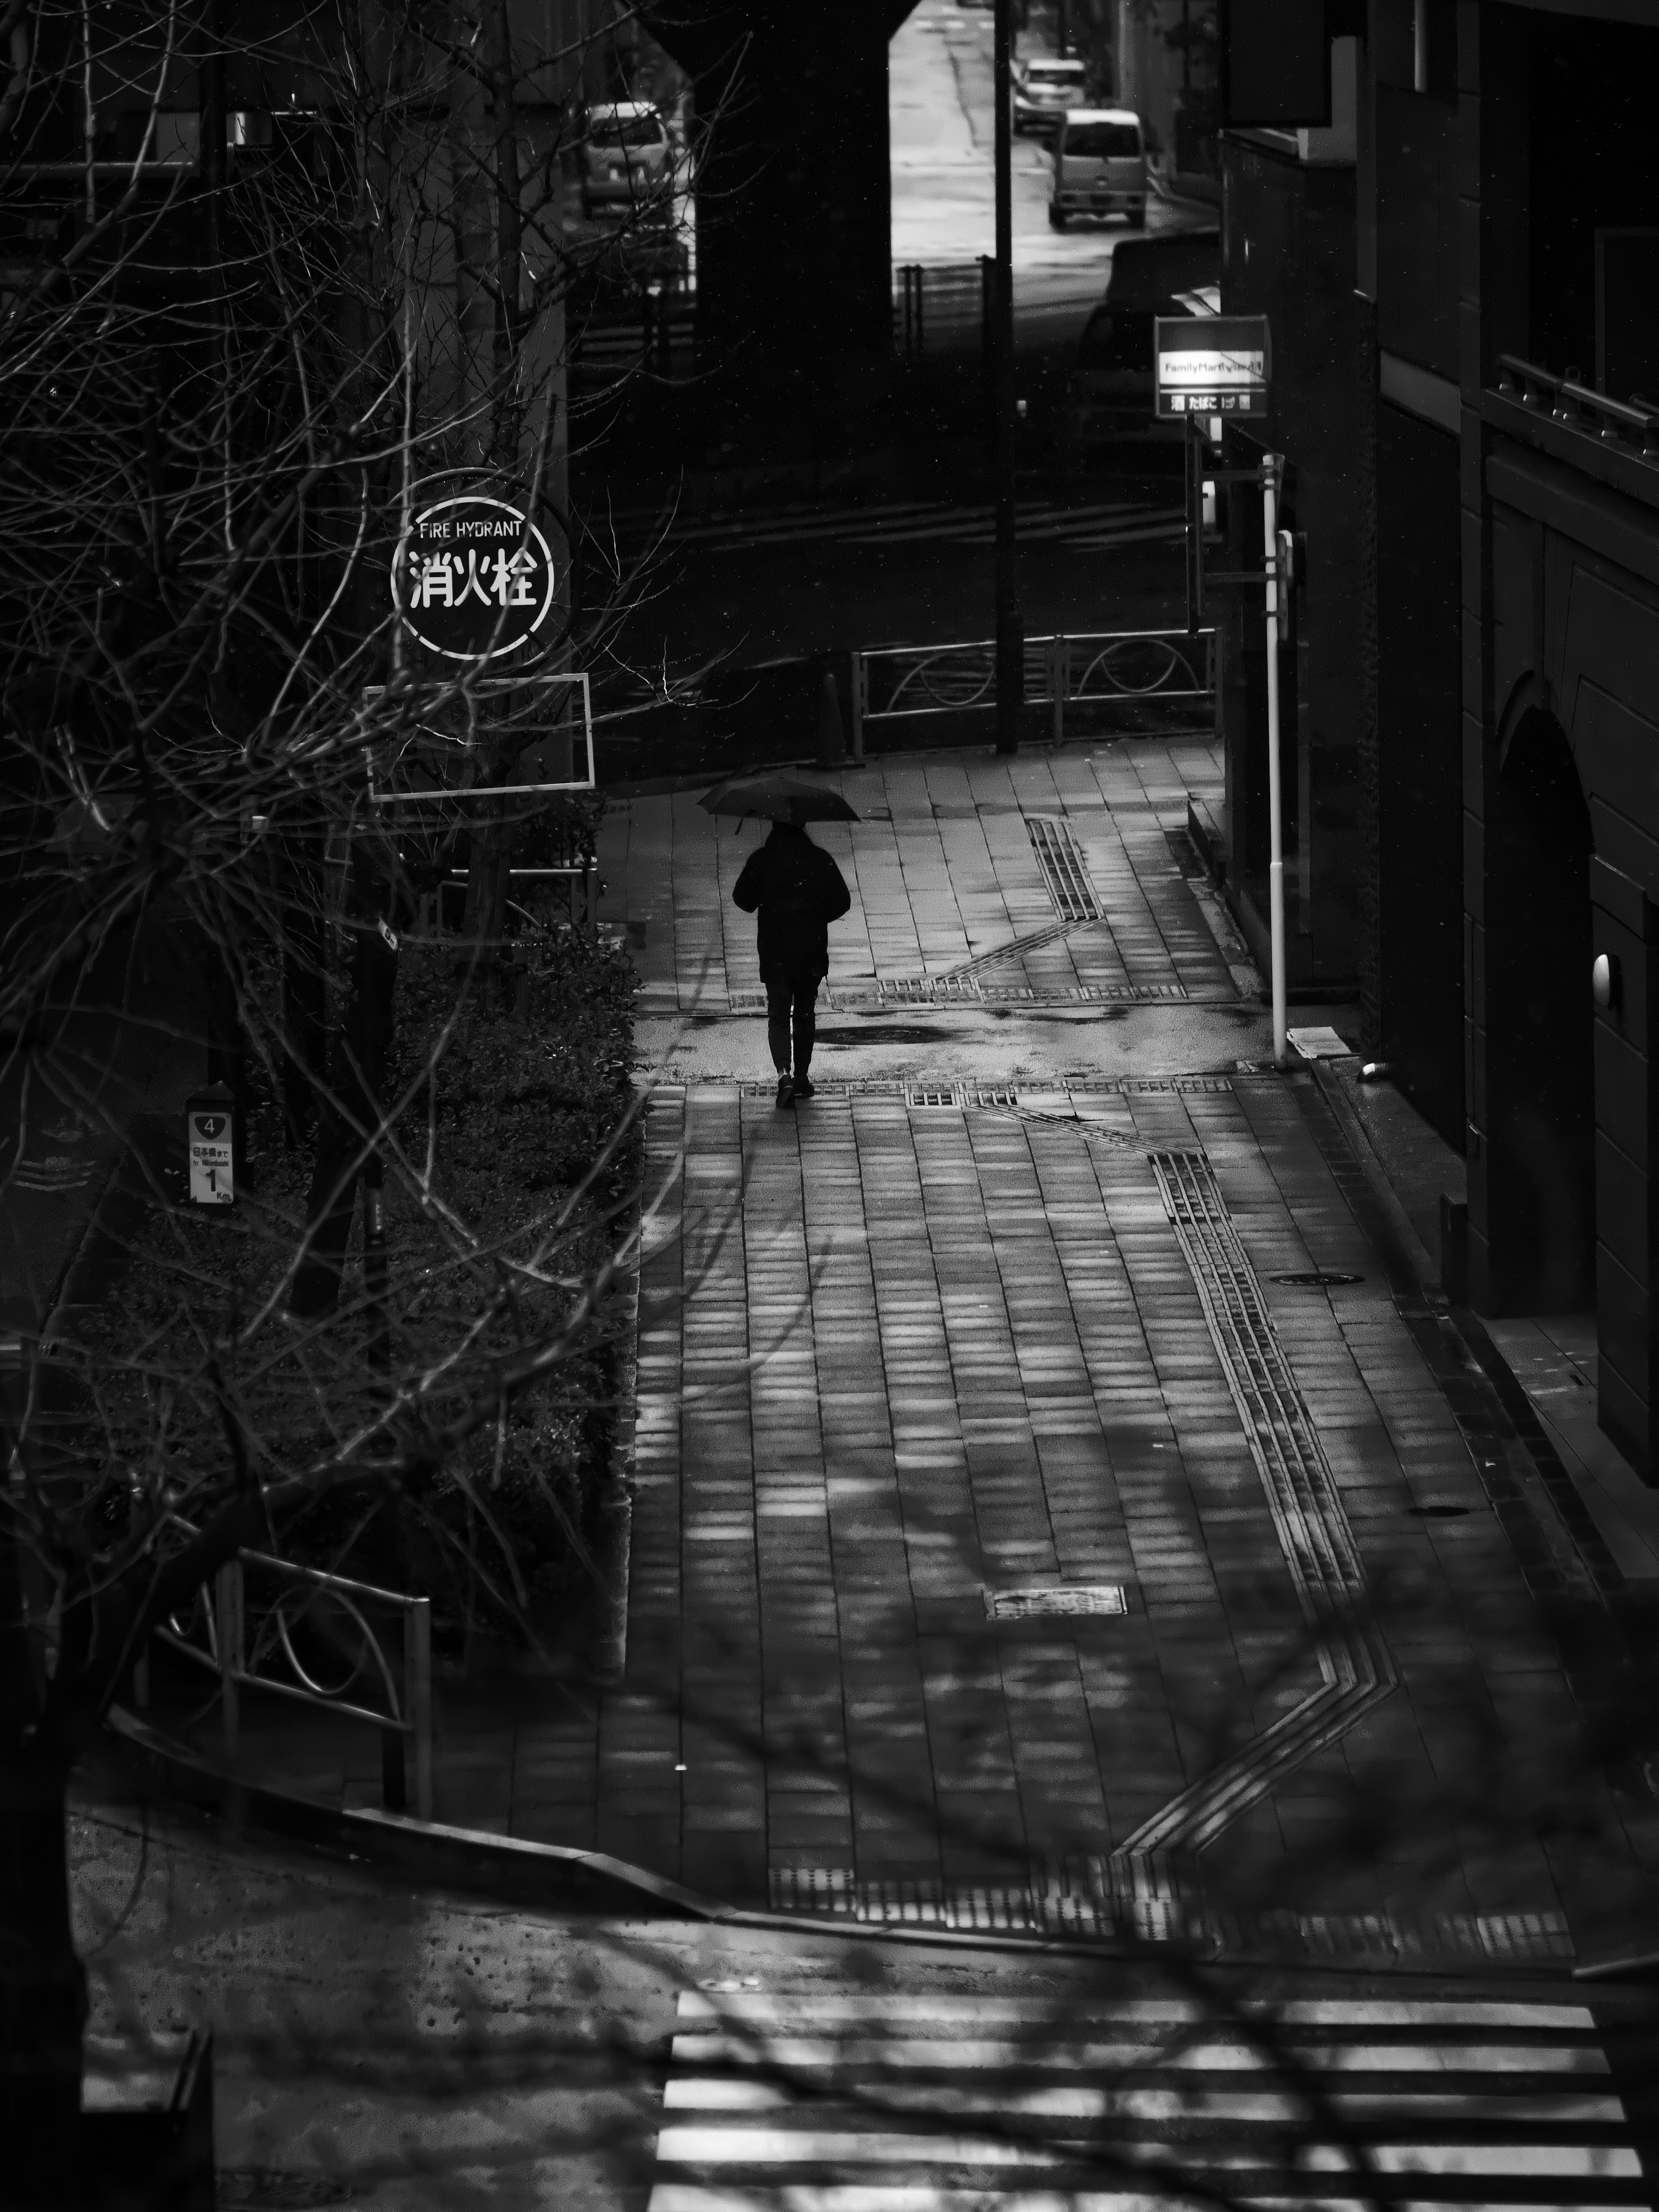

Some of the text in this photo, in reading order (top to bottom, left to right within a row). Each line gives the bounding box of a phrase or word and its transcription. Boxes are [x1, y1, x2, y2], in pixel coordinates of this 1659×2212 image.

[420, 521, 522, 538] FIRE HYDRANT
[408, 548, 538, 608] 消火栓
[204, 1118, 215, 1134] 4
[206, 1169, 216, 1192] 1
[216, 1192, 230, 1200] Km
